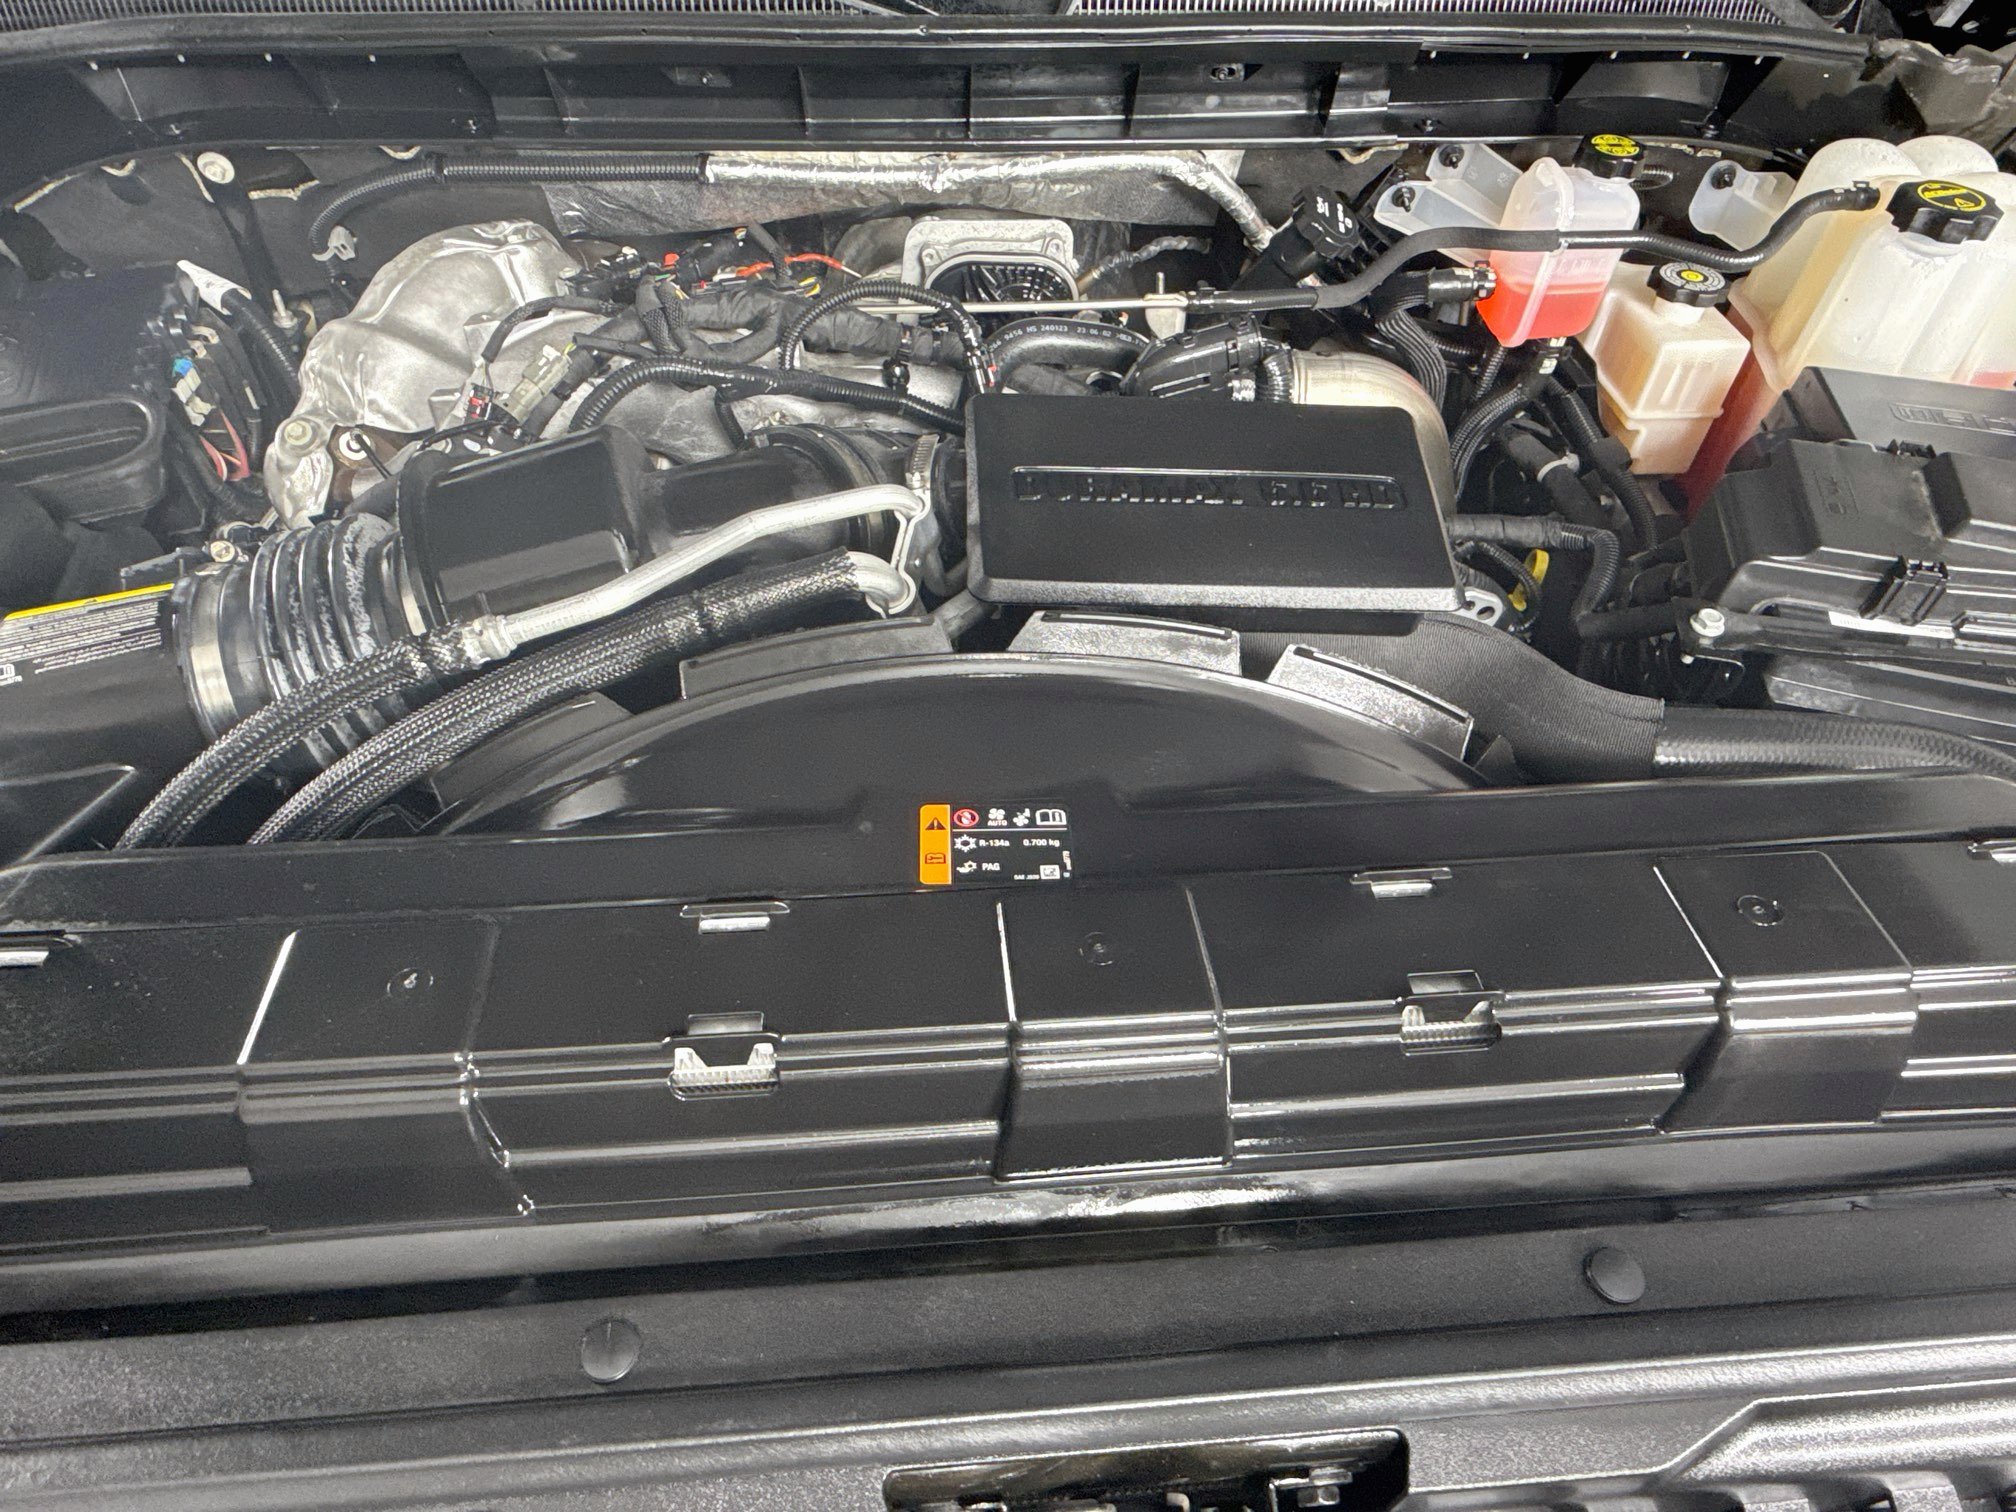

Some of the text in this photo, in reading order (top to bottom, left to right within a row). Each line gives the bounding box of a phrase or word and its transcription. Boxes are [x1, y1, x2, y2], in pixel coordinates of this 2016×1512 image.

[979, 838, 1060, 848] R-134a 0.700 kg
[982, 863, 1001, 871] PAG
